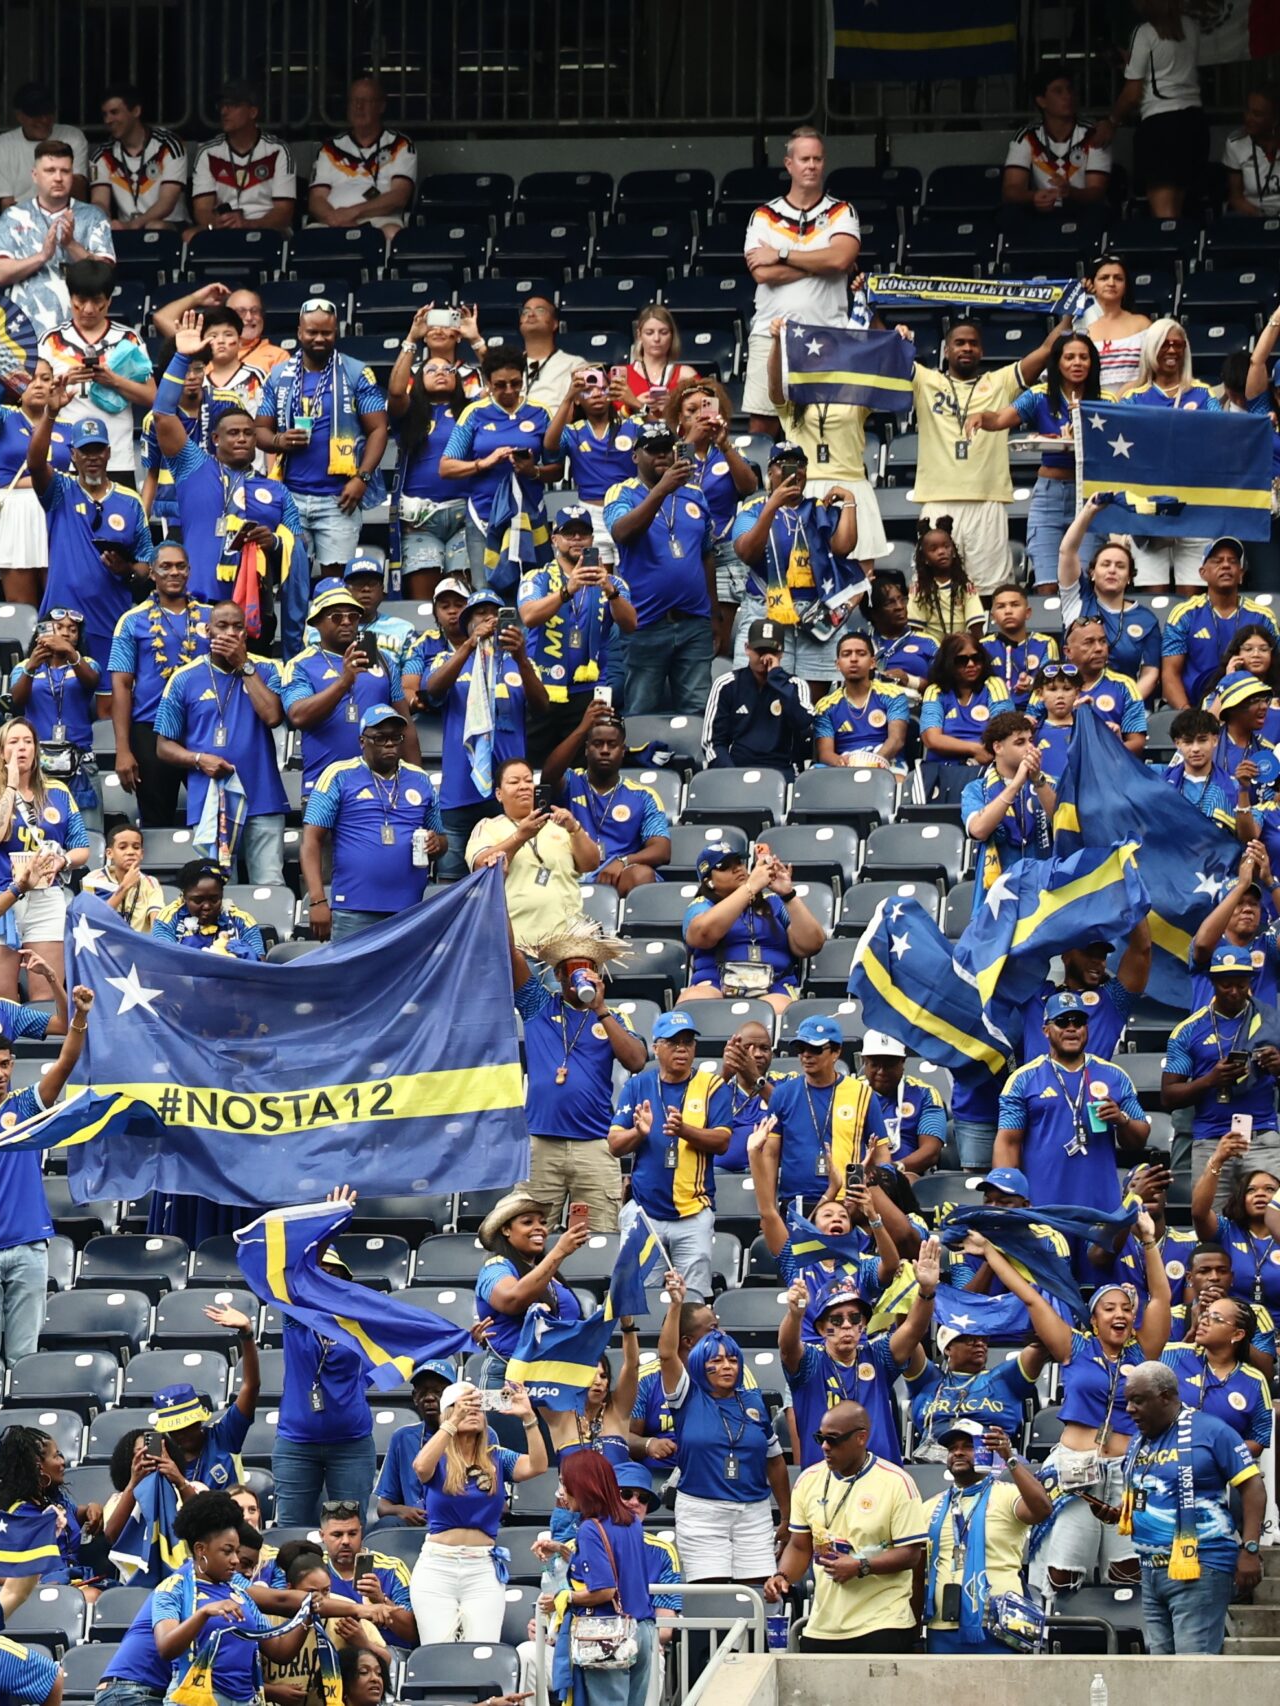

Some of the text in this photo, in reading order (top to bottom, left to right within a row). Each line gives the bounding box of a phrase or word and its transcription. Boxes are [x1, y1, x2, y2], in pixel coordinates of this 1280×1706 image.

[936, 280, 1019, 297] KOMPLETU
[157, 1082, 394, 1133] #NOSTA12
[1181, 1465, 1195, 1509] NOS TEI
